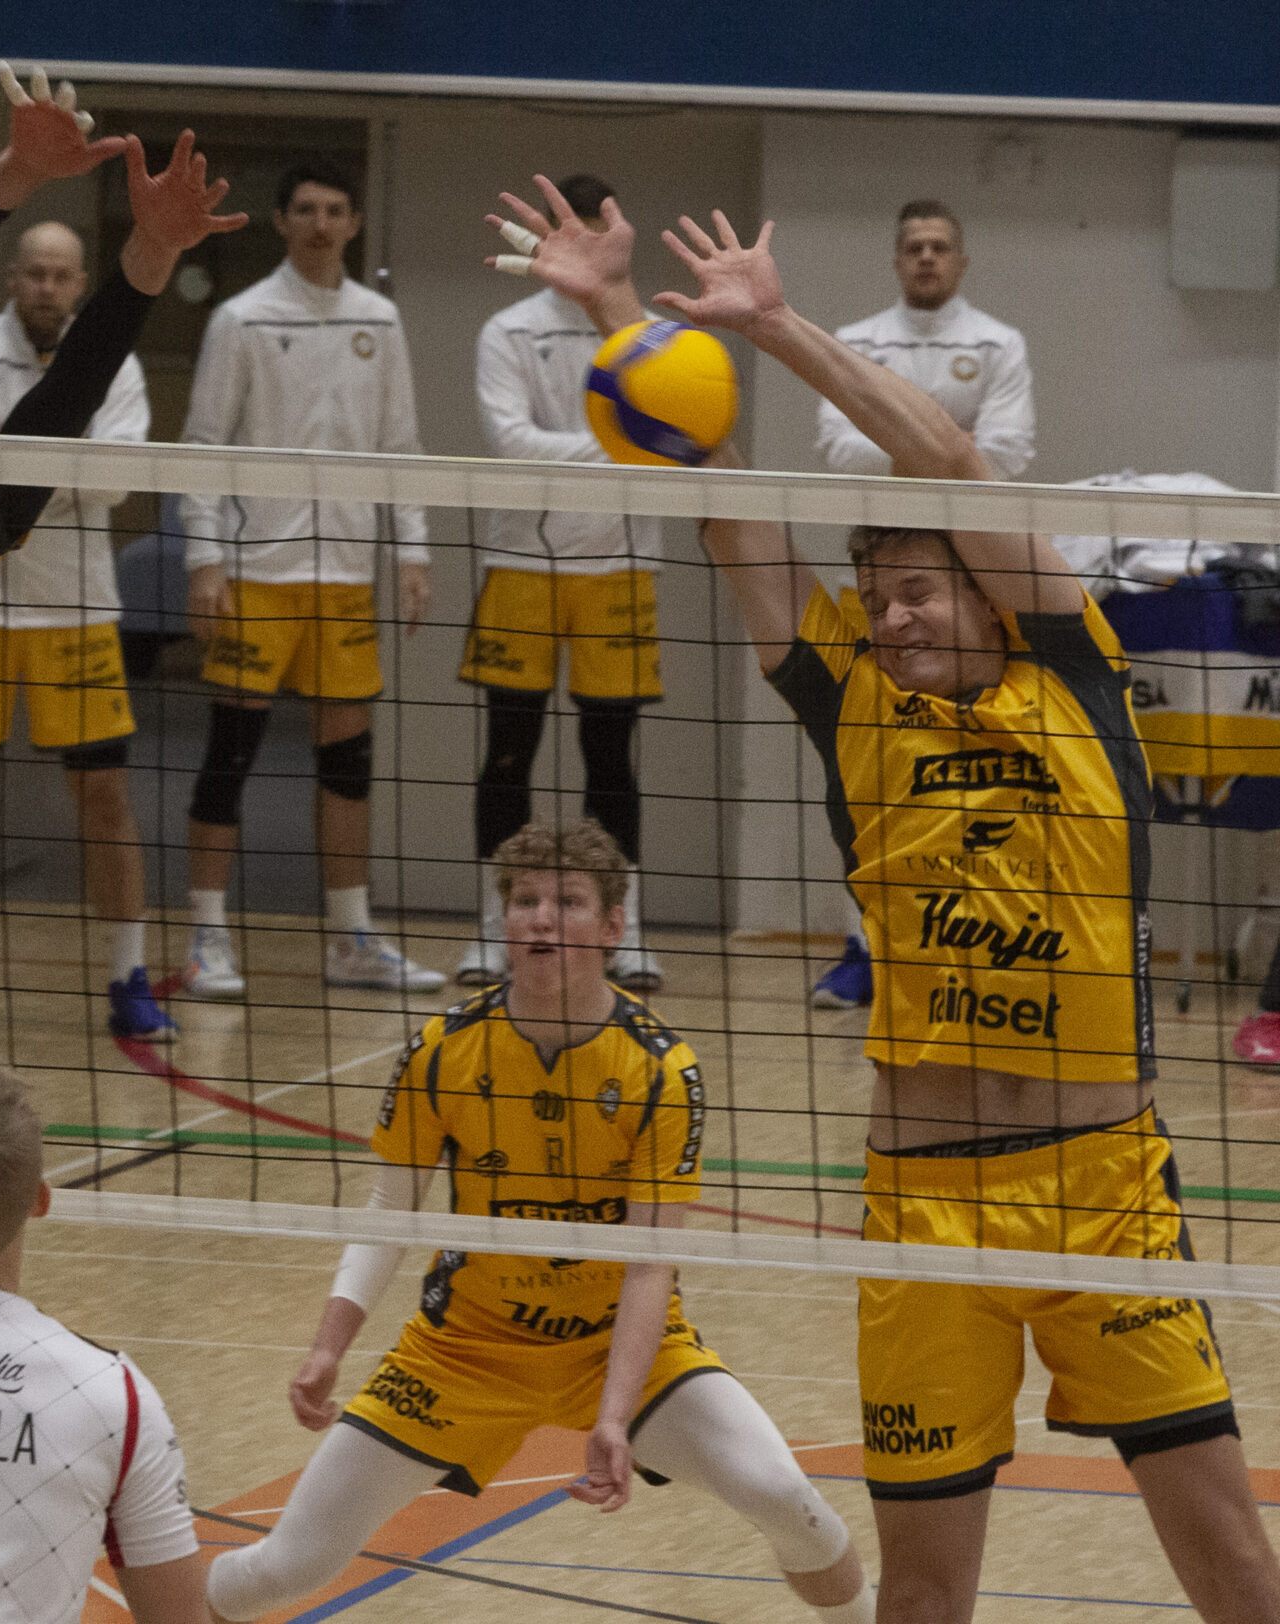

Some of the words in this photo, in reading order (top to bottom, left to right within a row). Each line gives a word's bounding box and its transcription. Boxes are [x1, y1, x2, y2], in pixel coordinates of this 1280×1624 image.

[915, 892, 1069, 969] Hurja
[502, 1299, 618, 1339] Hur
[862, 1400, 916, 1429] AVON
[863, 1426, 957, 1455] ANOMAT
